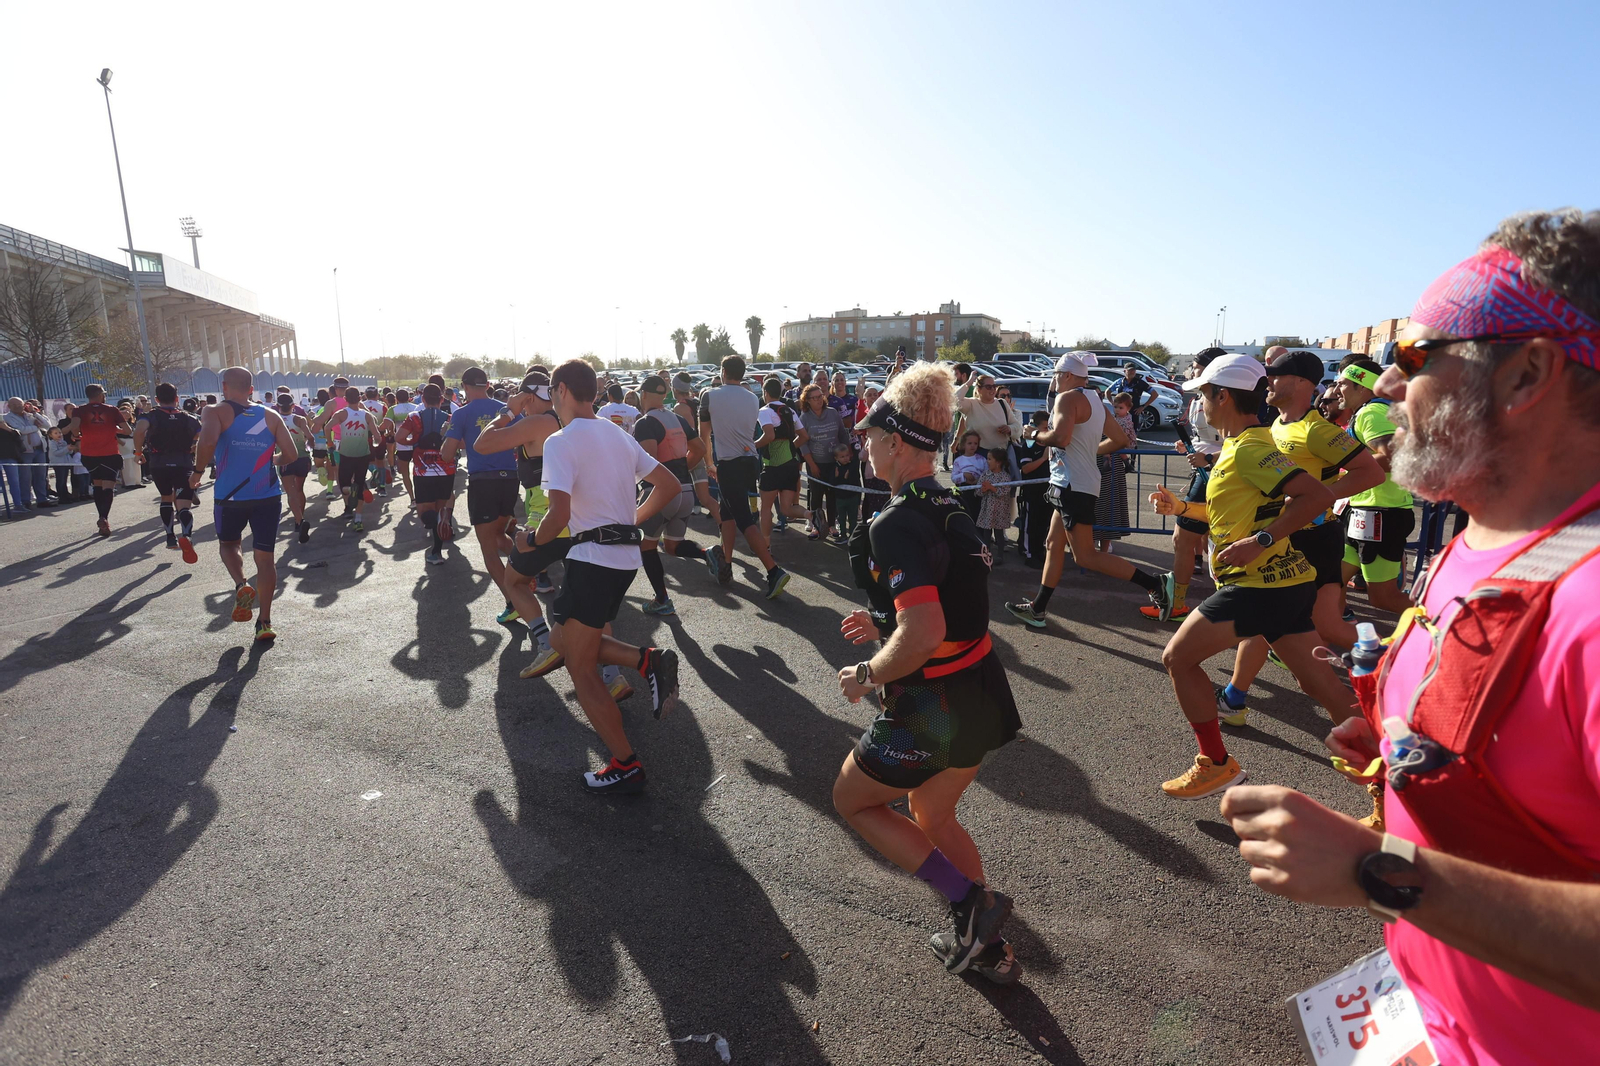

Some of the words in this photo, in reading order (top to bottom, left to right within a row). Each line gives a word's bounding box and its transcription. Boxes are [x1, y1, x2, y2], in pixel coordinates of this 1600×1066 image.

[898, 424, 936, 446] LURBEL
[1263, 573, 1276, 584] NO
[1279, 566, 1297, 580] HAY
[1335, 985, 1380, 1051] 375
